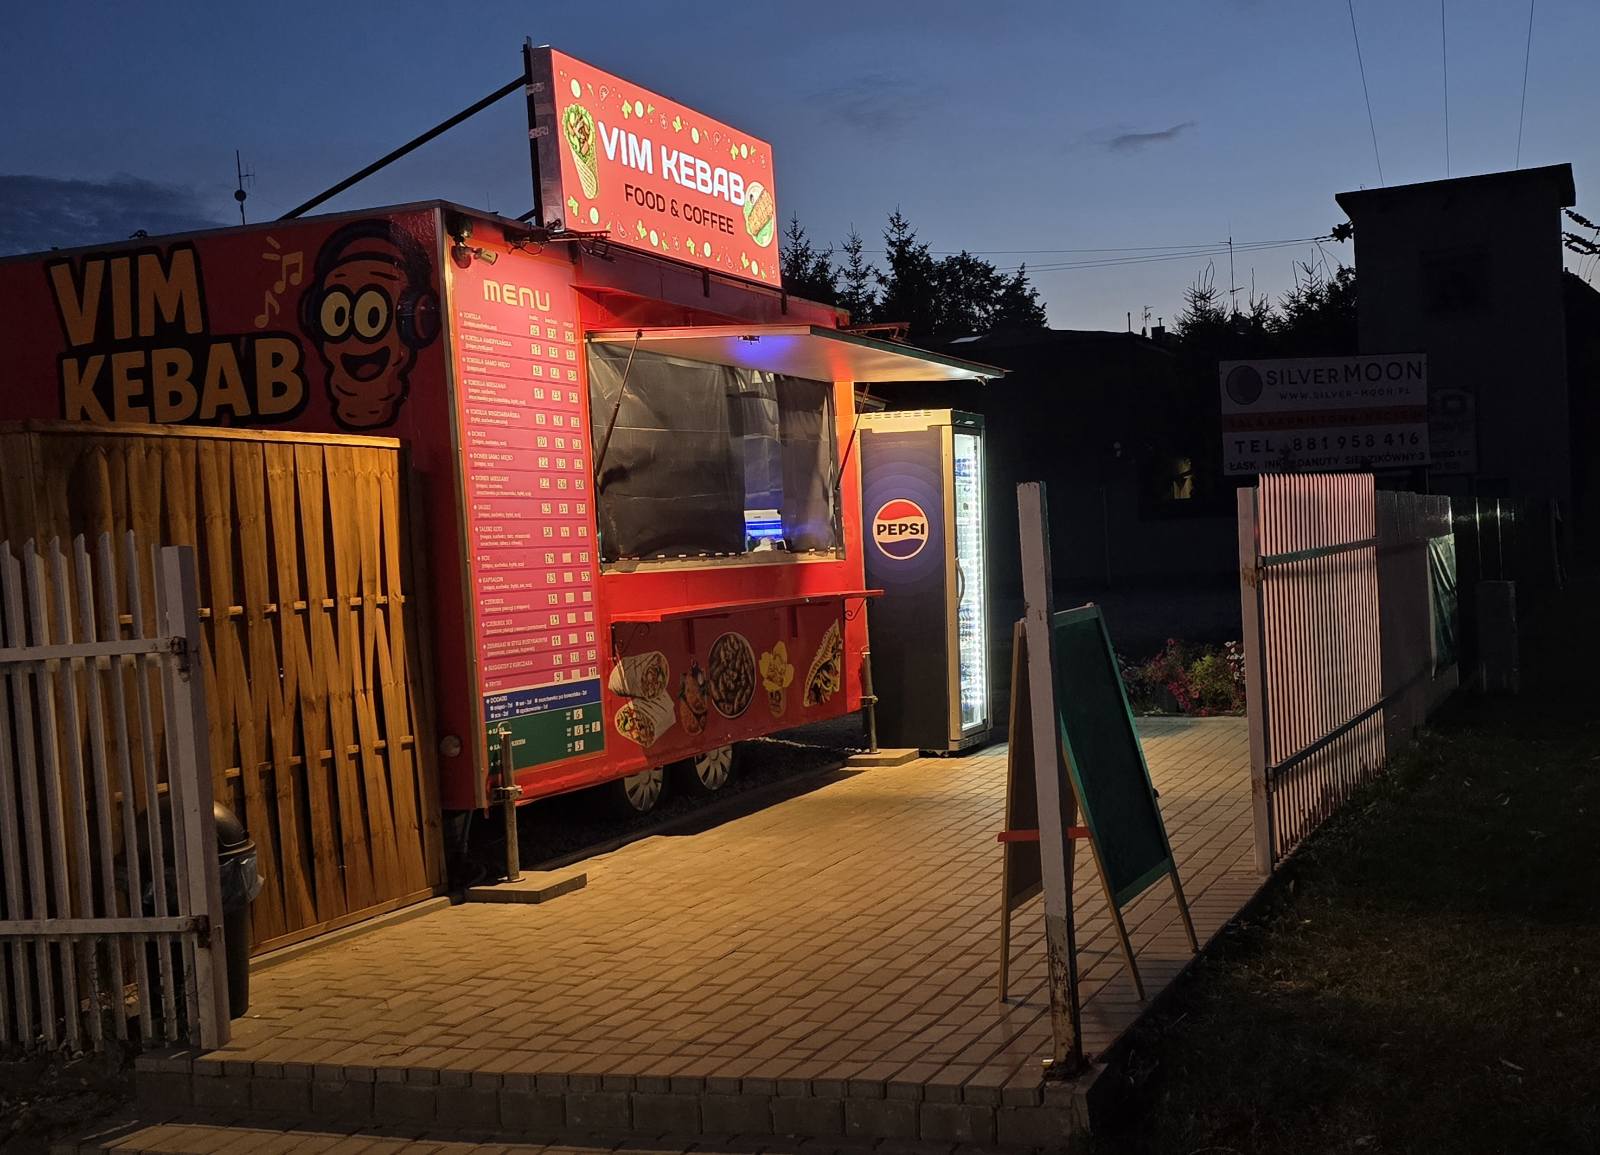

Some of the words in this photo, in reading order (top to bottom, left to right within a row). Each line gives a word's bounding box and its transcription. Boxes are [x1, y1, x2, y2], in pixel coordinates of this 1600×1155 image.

[598, 122, 653, 174] VIM
[661, 145, 746, 207] KEBAB
[624, 183, 666, 214] FOOD
[670, 199, 680, 216] &
[683, 203, 735, 236] COFFEE
[50, 248, 204, 347] VIM
[62, 337, 304, 423] KEBAB
[1266, 361, 1422, 386] SILVERMOON
[1293, 435, 1328, 451] 881
[1337, 433, 1376, 449] 958
[1383, 431, 1420, 447] 416
[876, 522, 926, 537] PEPSI
